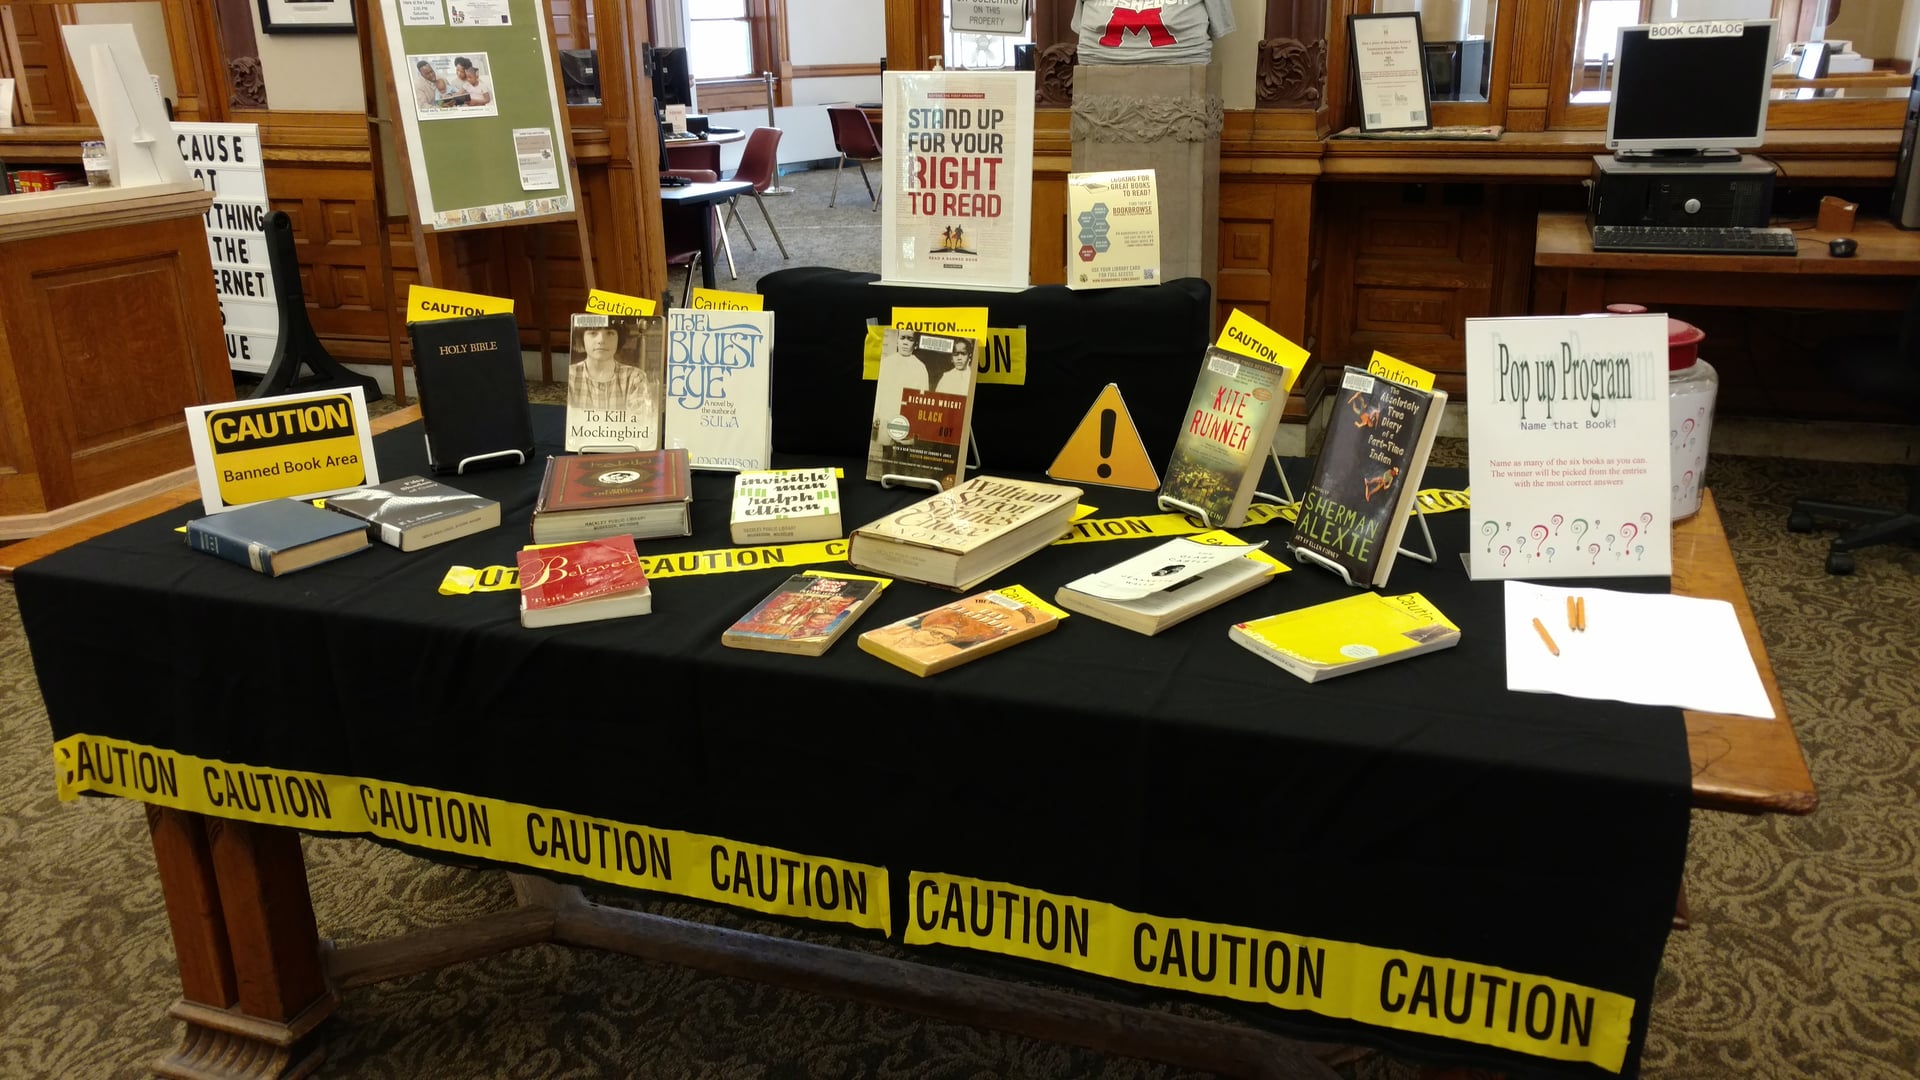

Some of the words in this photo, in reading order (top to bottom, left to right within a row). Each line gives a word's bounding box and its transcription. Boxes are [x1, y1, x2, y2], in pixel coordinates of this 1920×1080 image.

[970, 16, 1005, 25] PROPERTY
[973, 6, 983, 14] ON
[986, 6, 1000, 14] THIS
[1652, 26, 1684, 36] BOOK
[1688, 24, 1743, 34] CATALOG
[908, 108, 971, 130] STAND
[978, 108, 1004, 130] UP
[177, 134, 244, 162] CAUSE
[908, 132, 945, 153] FOR
[951, 132, 1003, 154] YOUR
[194, 168, 217, 192] OT
[908, 156, 1002, 190] RIGHT
[908, 192, 936, 216] TO
[942, 192, 1002, 218] READ
[213, 236, 250, 264] THE
[214, 268, 265, 298] ERNET
[421, 300, 485, 316] CAUTION
[587, 296, 642, 316] Caution
[694, 296, 749, 311] Caution
[670, 313, 706, 332] THE
[440, 344, 468, 356] HOLY
[470, 341, 498, 353] BIBLE
[668, 330, 764, 370] BLUEST
[1370, 360, 1419, 388] Caution
[1498, 343, 1530, 420] Pop
[1534, 360, 1556, 420] up
[1560, 342, 1632, 418] Program
[668, 364, 727, 410] EYE
[1390, 386, 1400, 396] The
[726, 400, 734, 408] by
[908, 395, 936, 406] RICHARD
[938, 399, 962, 410] WRIGHT
[1213, 385, 1251, 418] KITE
[1380, 392, 1420, 416] Absolutely
[1388, 406, 1405, 420] True
[213, 403, 349, 444] CAUTION
[584, 410, 600, 422] To
[604, 410, 626, 422] Kill
[700, 414, 740, 428] SULA
[918, 410, 943, 423] BLACK
[1381, 417, 1402, 433] Diary
[1520, 422, 1547, 430] Name
[1553, 421, 1578, 430] that
[1585, 419, 1617, 429] Book!
[571, 425, 649, 442] Mockingbird
[1189, 409, 1251, 452] RUNNER
[1368, 434, 1405, 456] Part-Time
[1369, 448, 1392, 465] Indian
[224, 463, 280, 483] Banned
[284, 457, 322, 474] Book
[326, 454, 358, 467] Area
[697, 456, 759, 470] MORRISON
[1489, 460, 1511, 468] Name
[1523, 460, 1544, 468] many
[1546, 458, 1555, 466] of
[1569, 458, 1580, 466] six
[1616, 459, 1630, 467] you
[1491, 470, 1505, 478] The
[1562, 468, 1587, 477] picked
[1589, 468, 1607, 476] from
[1622, 467, 1647, 475] entries
[742, 472, 830, 486] invisible
[1514, 480, 1531, 488] with
[1533, 480, 1544, 488] the
[1566, 479, 1592, 487] correct
[959, 491, 1035, 514] Styron
[967, 479, 1062, 503] William
[1305, 492, 1379, 539] SHERMAN
[1059, 519, 1153, 540] TION
[1298, 512, 1374, 562] ALEXIE
[520, 554, 634, 591] Beloved
[640, 548, 785, 575] CAUTION
[62, 741, 179, 798] CAUTION
[203, 765, 332, 820] CAUTION
[360, 784, 492, 847] CAUTION
[526, 812, 672, 881] CAUTION
[710, 844, 867, 915] CAUTION
[916, 880, 1090, 958] CAUTION
[1133, 922, 1326, 999] CAUTION
[1380, 958, 1595, 1048] CAUTION
